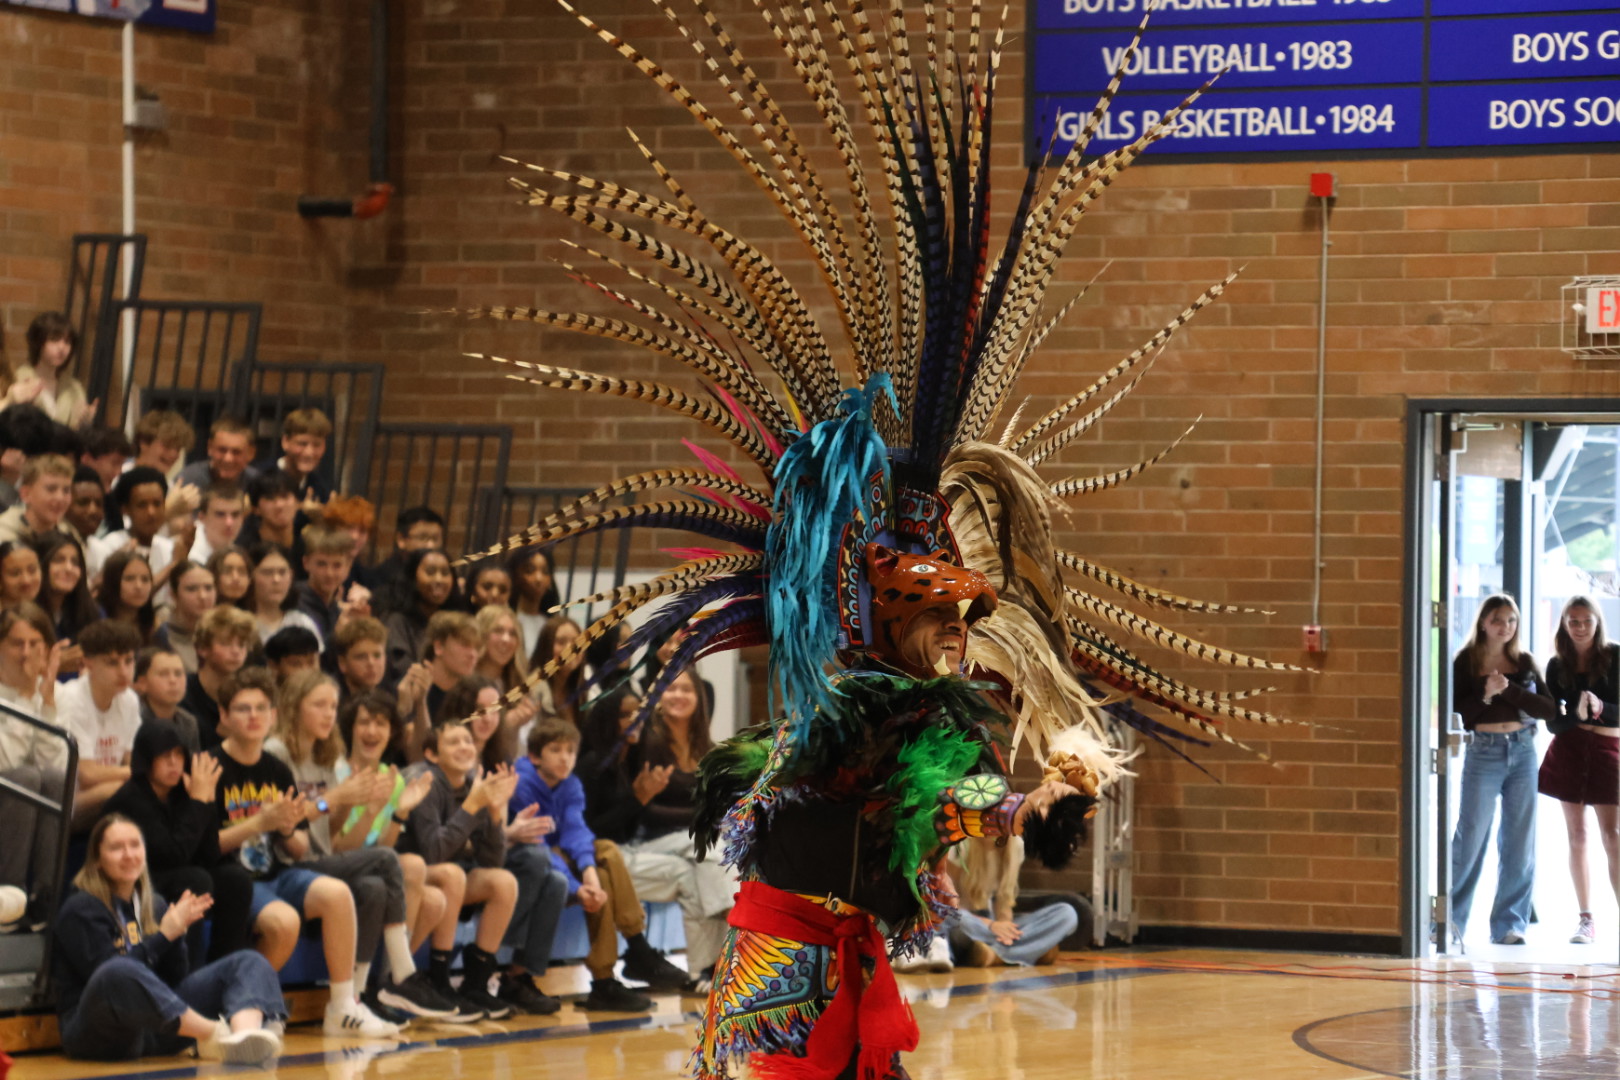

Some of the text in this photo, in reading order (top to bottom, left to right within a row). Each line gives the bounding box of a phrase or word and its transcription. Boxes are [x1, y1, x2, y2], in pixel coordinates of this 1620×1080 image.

[1512, 29, 1620, 63] BOYS G
[1489, 96, 1620, 130] BOYS SO
